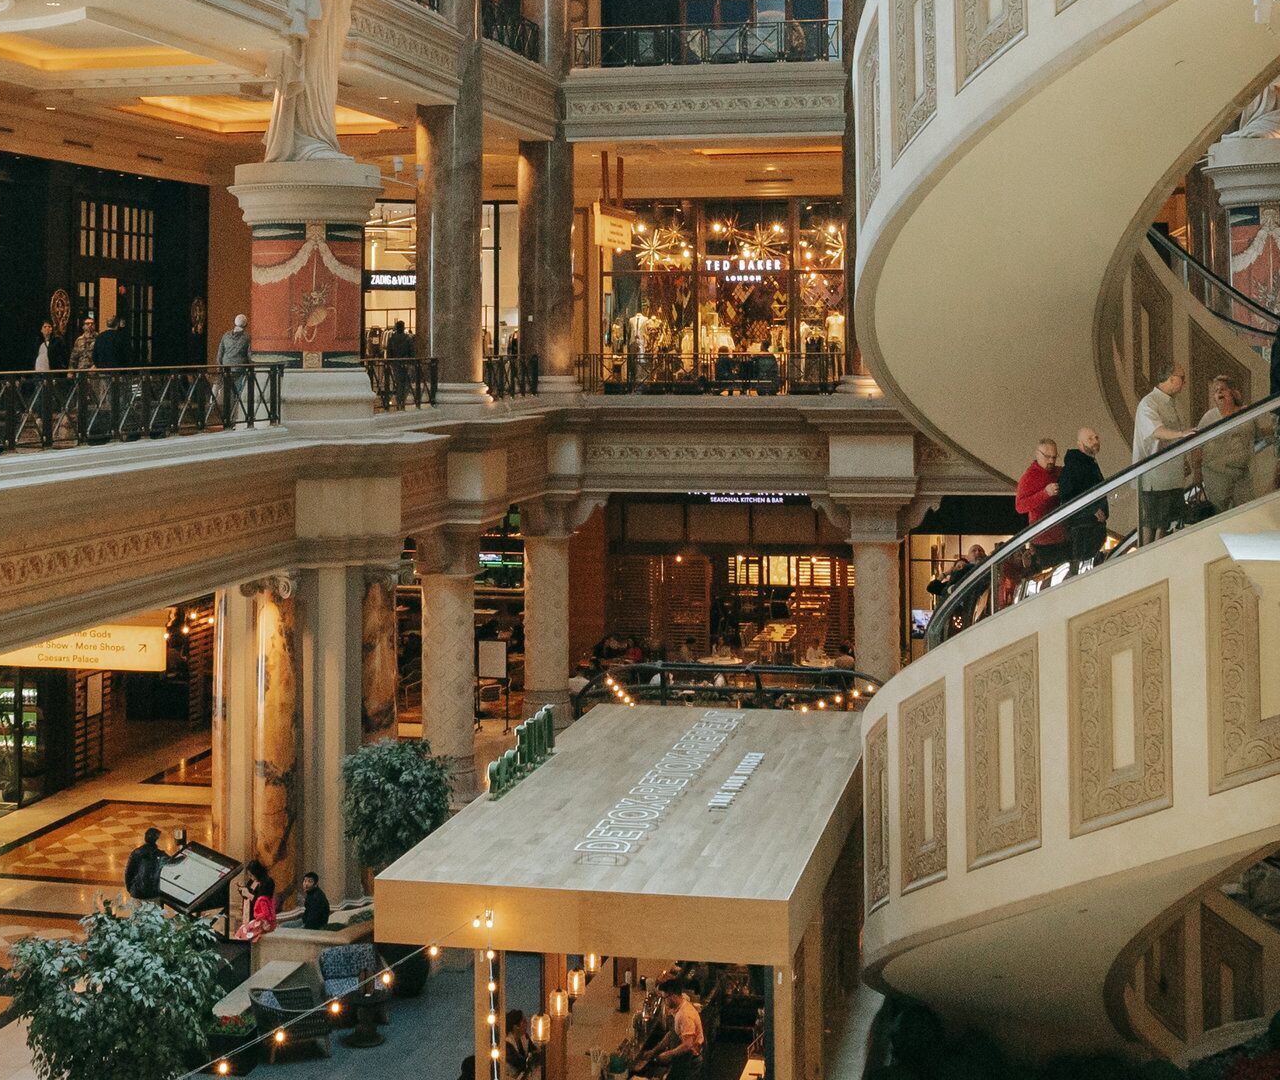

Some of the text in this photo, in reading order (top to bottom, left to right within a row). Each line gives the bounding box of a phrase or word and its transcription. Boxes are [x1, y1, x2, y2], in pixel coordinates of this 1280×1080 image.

[705, 259, 781, 271] TED BAKER
[89, 629, 112, 638] Gods
[46, 641, 68, 649] Show
[75, 642, 98, 650] More
[100, 642, 125, 652] Shops
[37, 653, 99, 663] Caesars Palace
